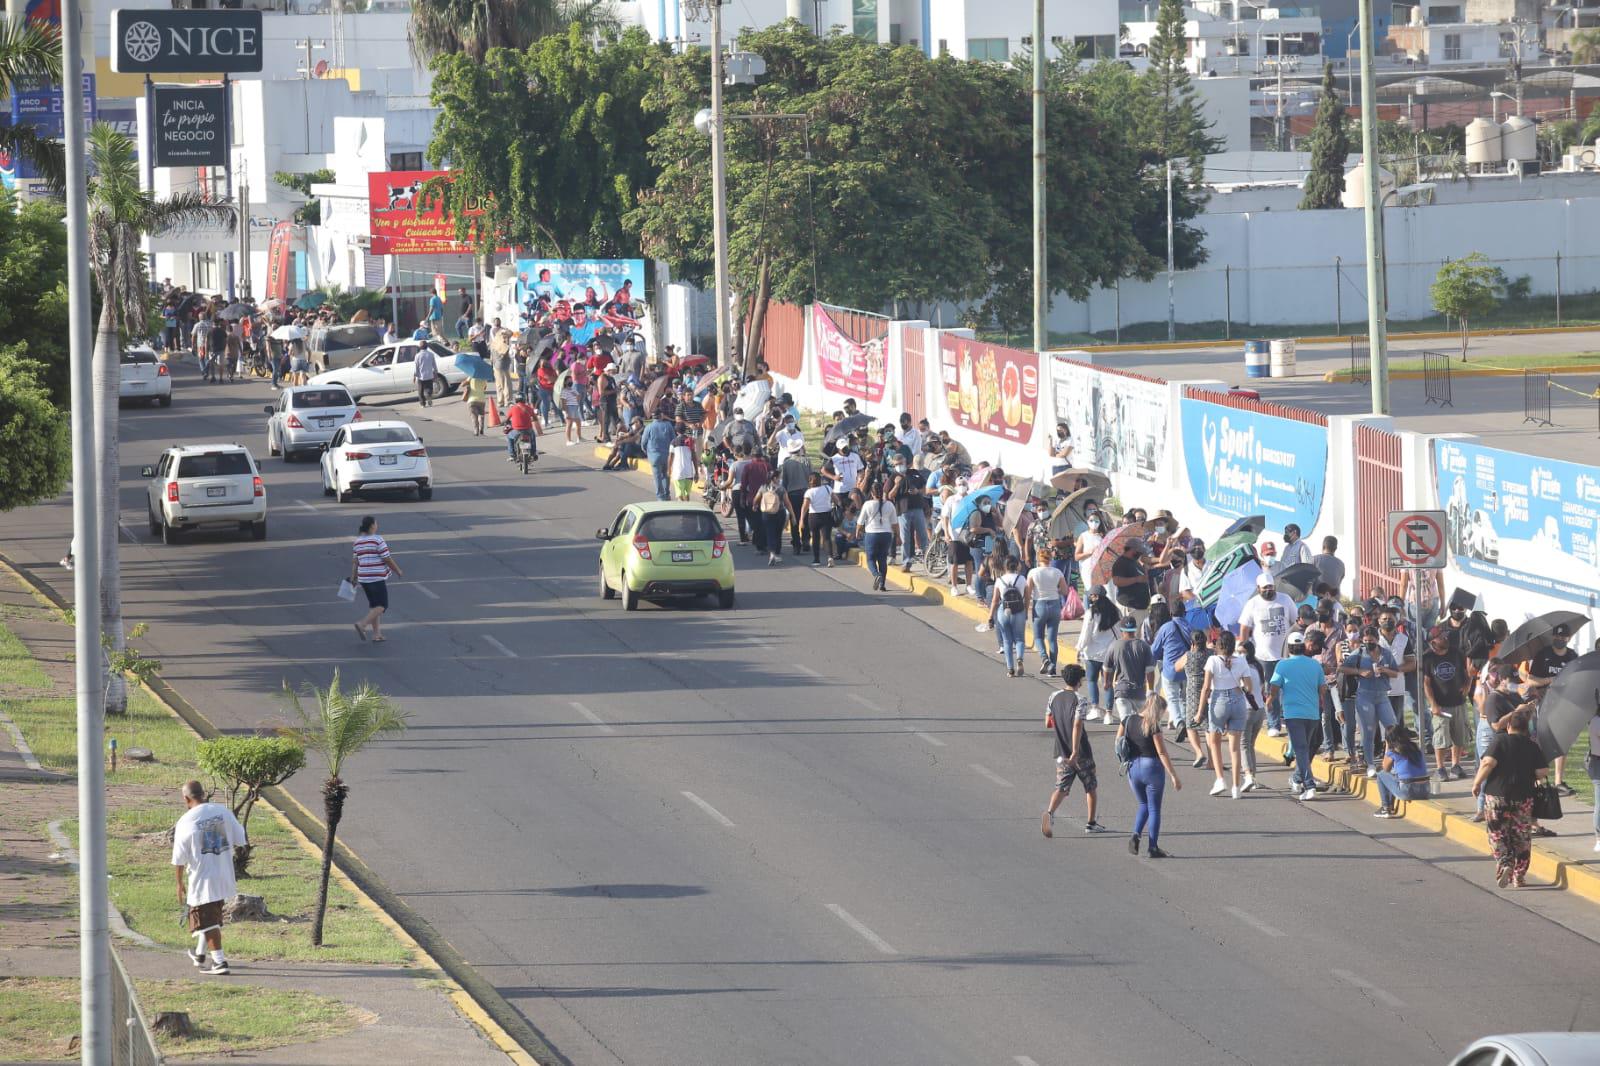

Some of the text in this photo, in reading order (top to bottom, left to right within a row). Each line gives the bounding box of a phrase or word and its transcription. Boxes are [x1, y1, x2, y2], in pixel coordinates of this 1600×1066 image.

[168, 27, 256, 56] NICE
[20, 98, 41, 106] ARCO
[173, 100, 205, 110] INICIA
[162, 109, 215, 130] tu propio
[165, 131, 215, 141] NEGOCIO
[534, 263, 631, 275] BIENVENIDOS
[1220, 416, 1254, 462] Sport
[1219, 458, 1253, 495] Medical
[1406, 525, 1429, 554] E
